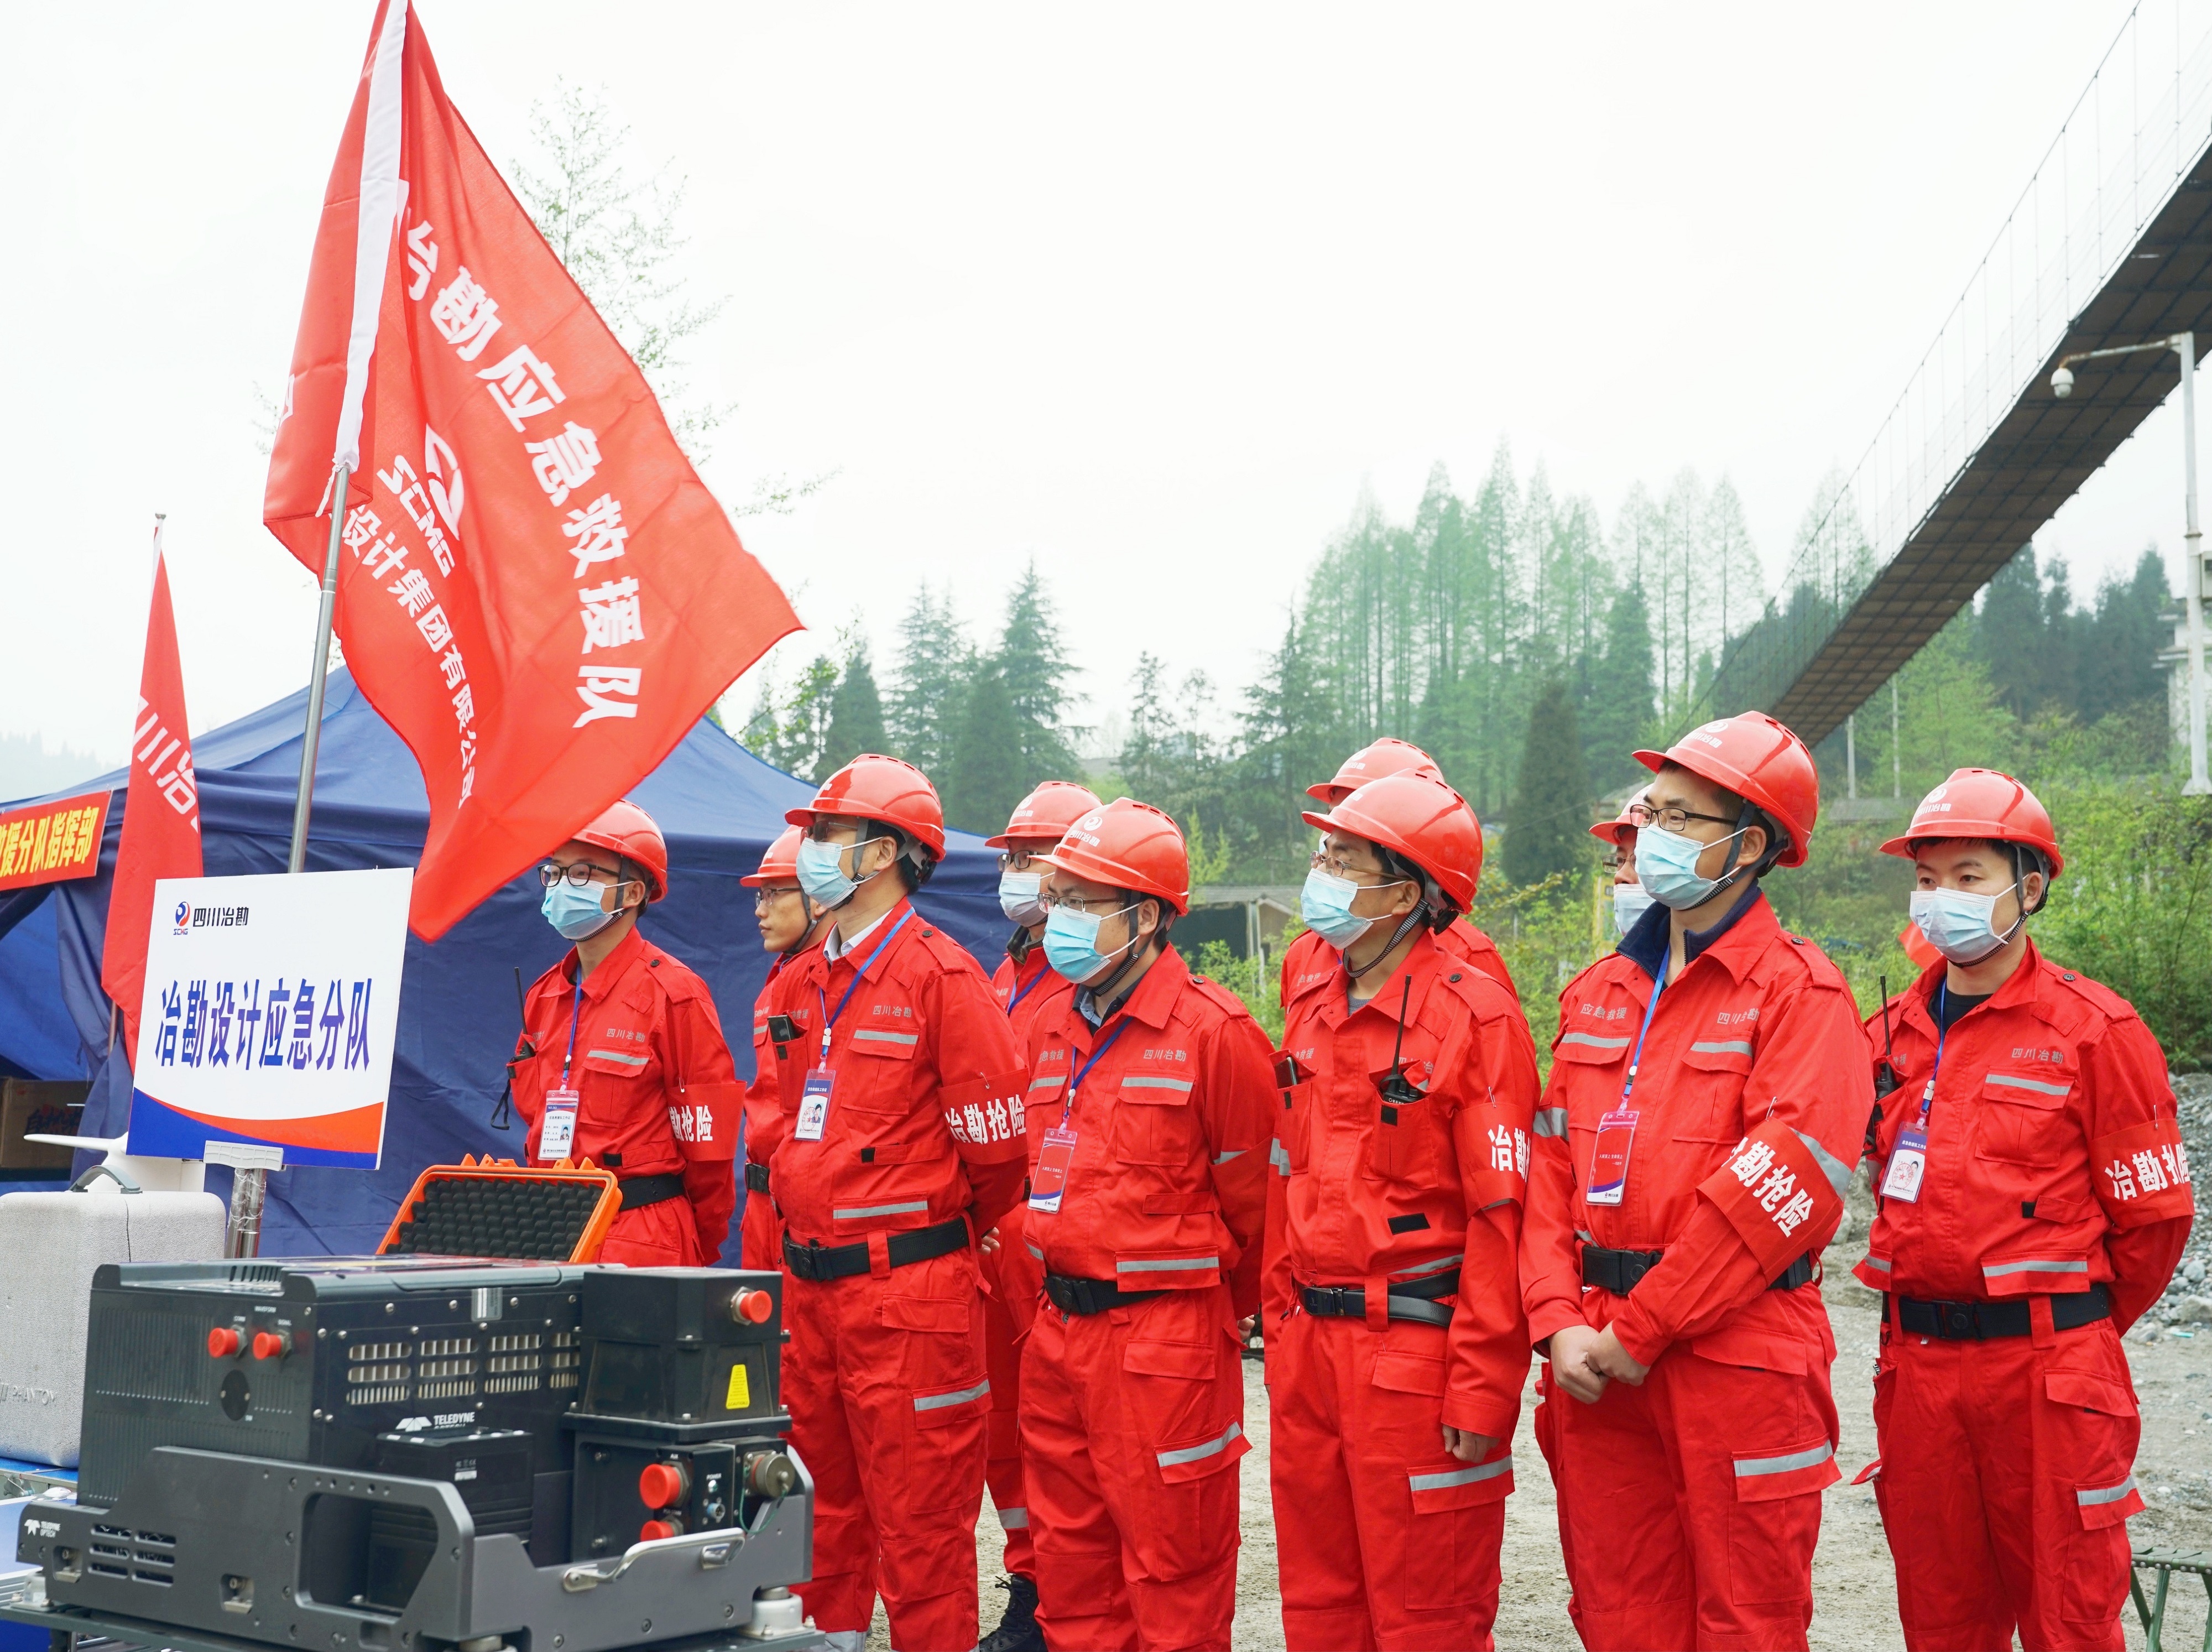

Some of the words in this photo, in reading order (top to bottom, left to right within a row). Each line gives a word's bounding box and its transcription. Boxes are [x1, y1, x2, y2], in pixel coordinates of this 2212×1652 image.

[192, 907, 249, 927] 四川冶勘
[872, 1005, 912, 1018] 四川冶勘
[1580, 1003, 1627, 1020] 应急救援
[154, 977, 374, 1072] 冶勘设计应急分队
[606, 1028, 646, 1043] 四川冶勘
[1142, 1049, 1187, 1062] 四川冶勘
[2011, 1048, 2064, 1064] 四川冶勘
[945, 1094, 1026, 1145] 冶勘抢险
[1488, 1124, 1531, 1183] 冶勘
[1721, 1137, 1814, 1238] 勘抢险
[434, 1411, 475, 1426] TELEDYNE
